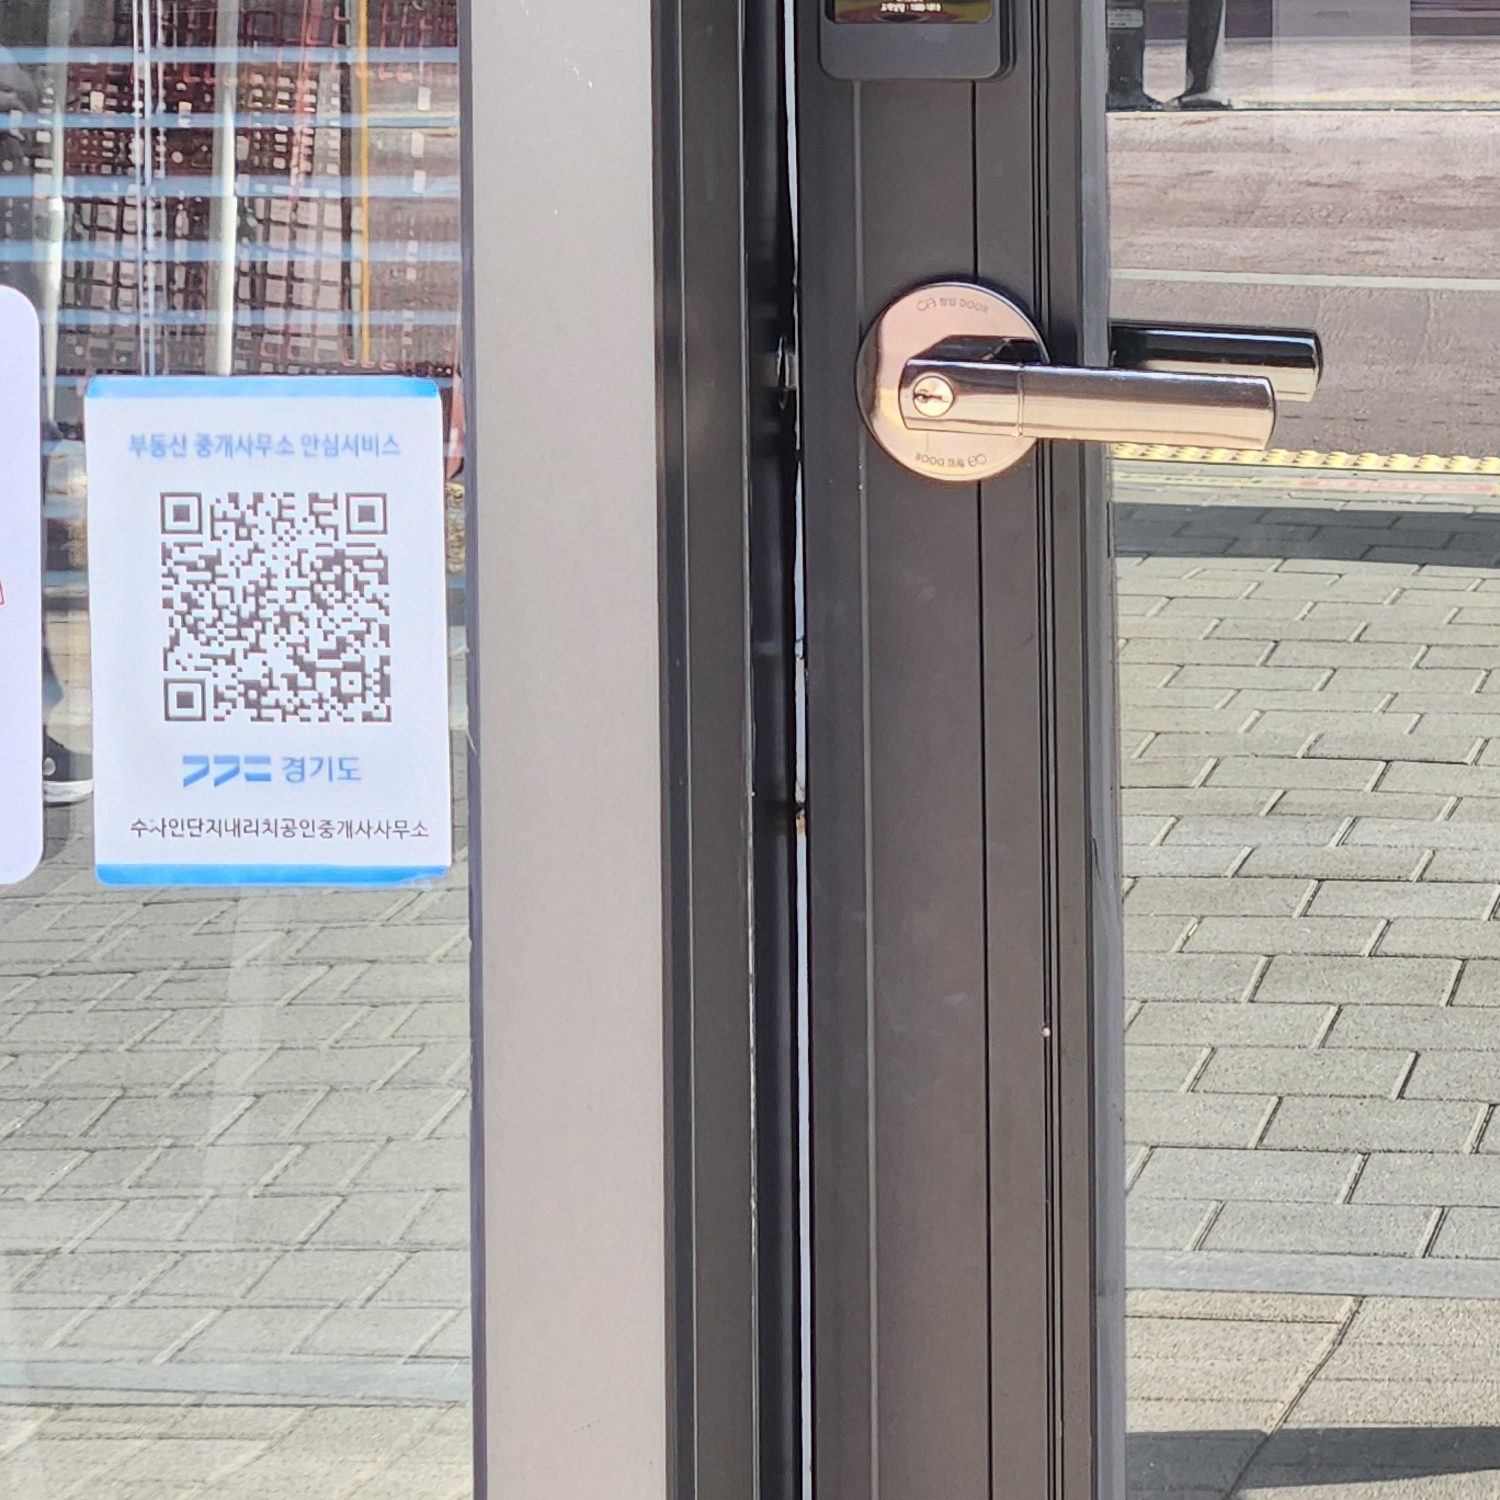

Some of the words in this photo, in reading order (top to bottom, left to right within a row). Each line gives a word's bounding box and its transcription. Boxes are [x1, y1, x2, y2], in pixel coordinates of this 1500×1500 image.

[128, 432, 188, 459] 부동산
[194, 432, 295, 459] 중개사무소
[299, 432, 402, 458] 안심서비스
[280, 755, 363, 784] 경기도
